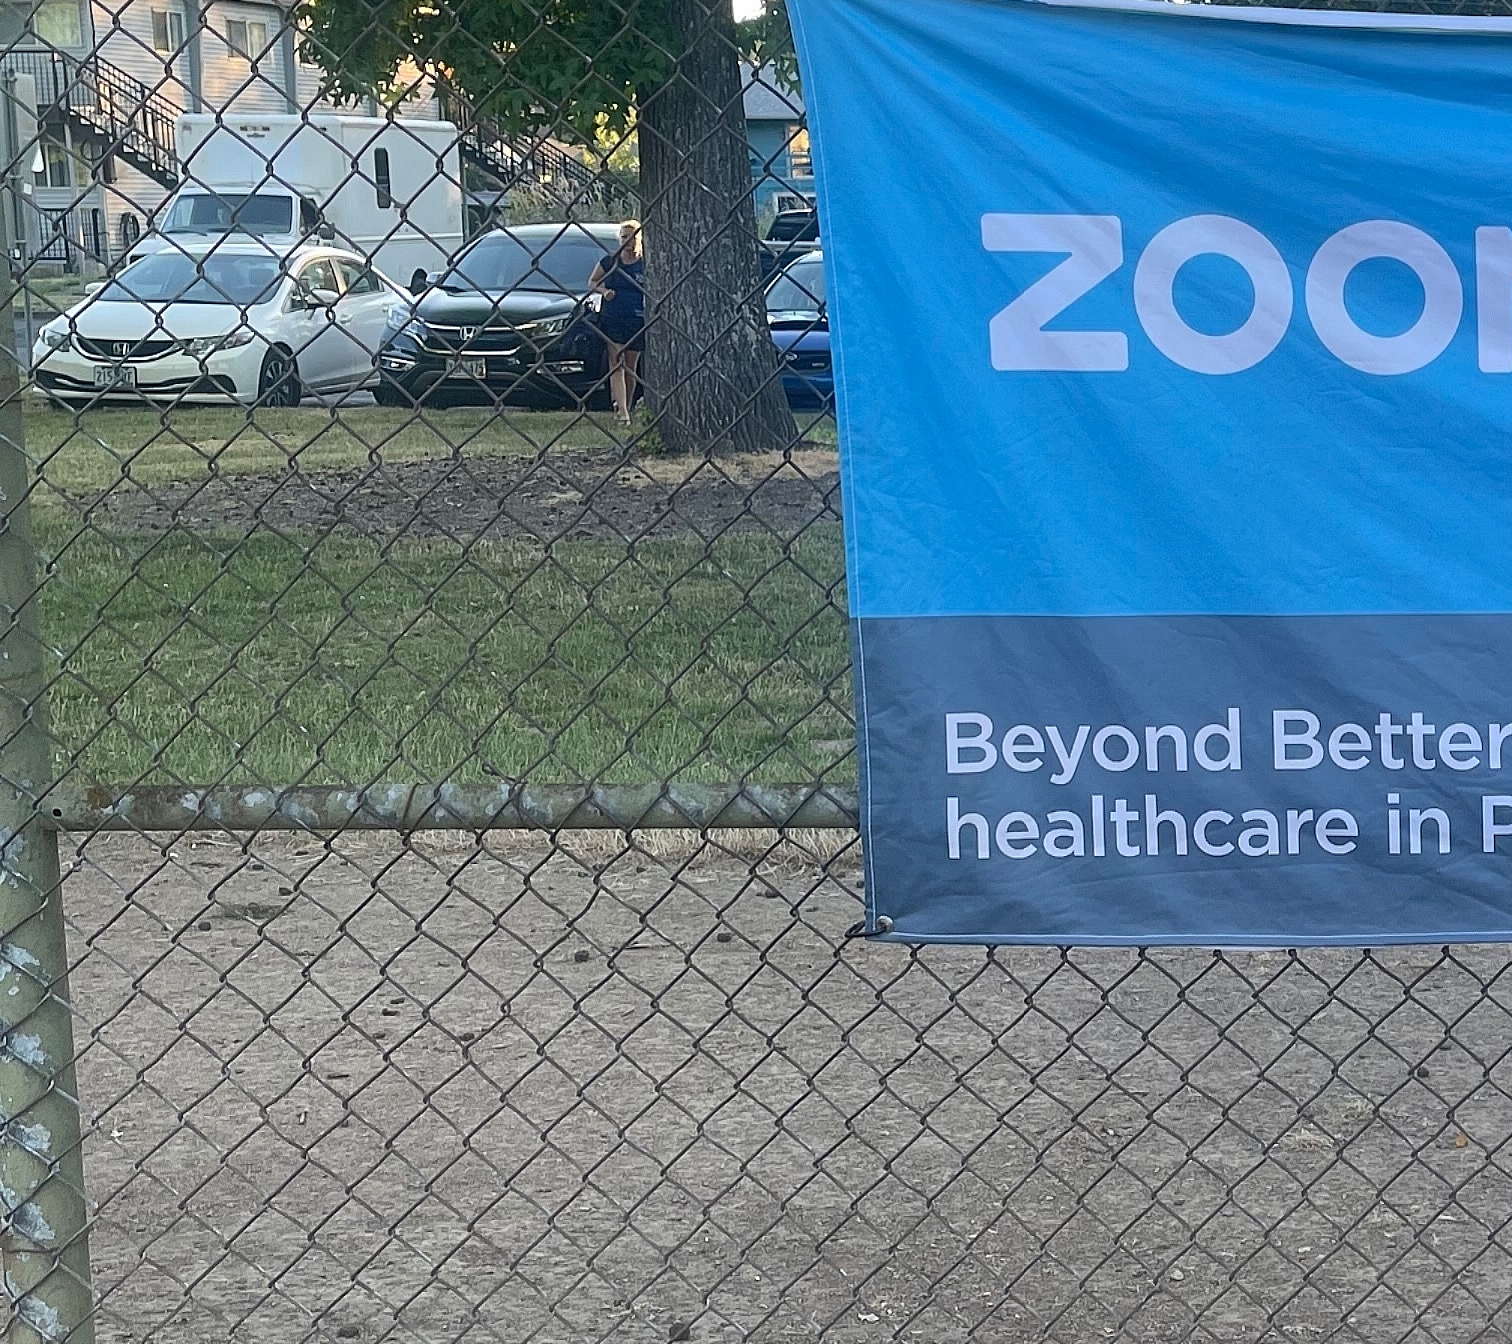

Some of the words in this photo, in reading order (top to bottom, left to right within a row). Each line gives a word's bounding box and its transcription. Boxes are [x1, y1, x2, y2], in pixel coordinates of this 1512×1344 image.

[945, 707, 1242, 785] Beyond
[946, 793, 1359, 860] healthcare
[1387, 792, 1451, 855] in
